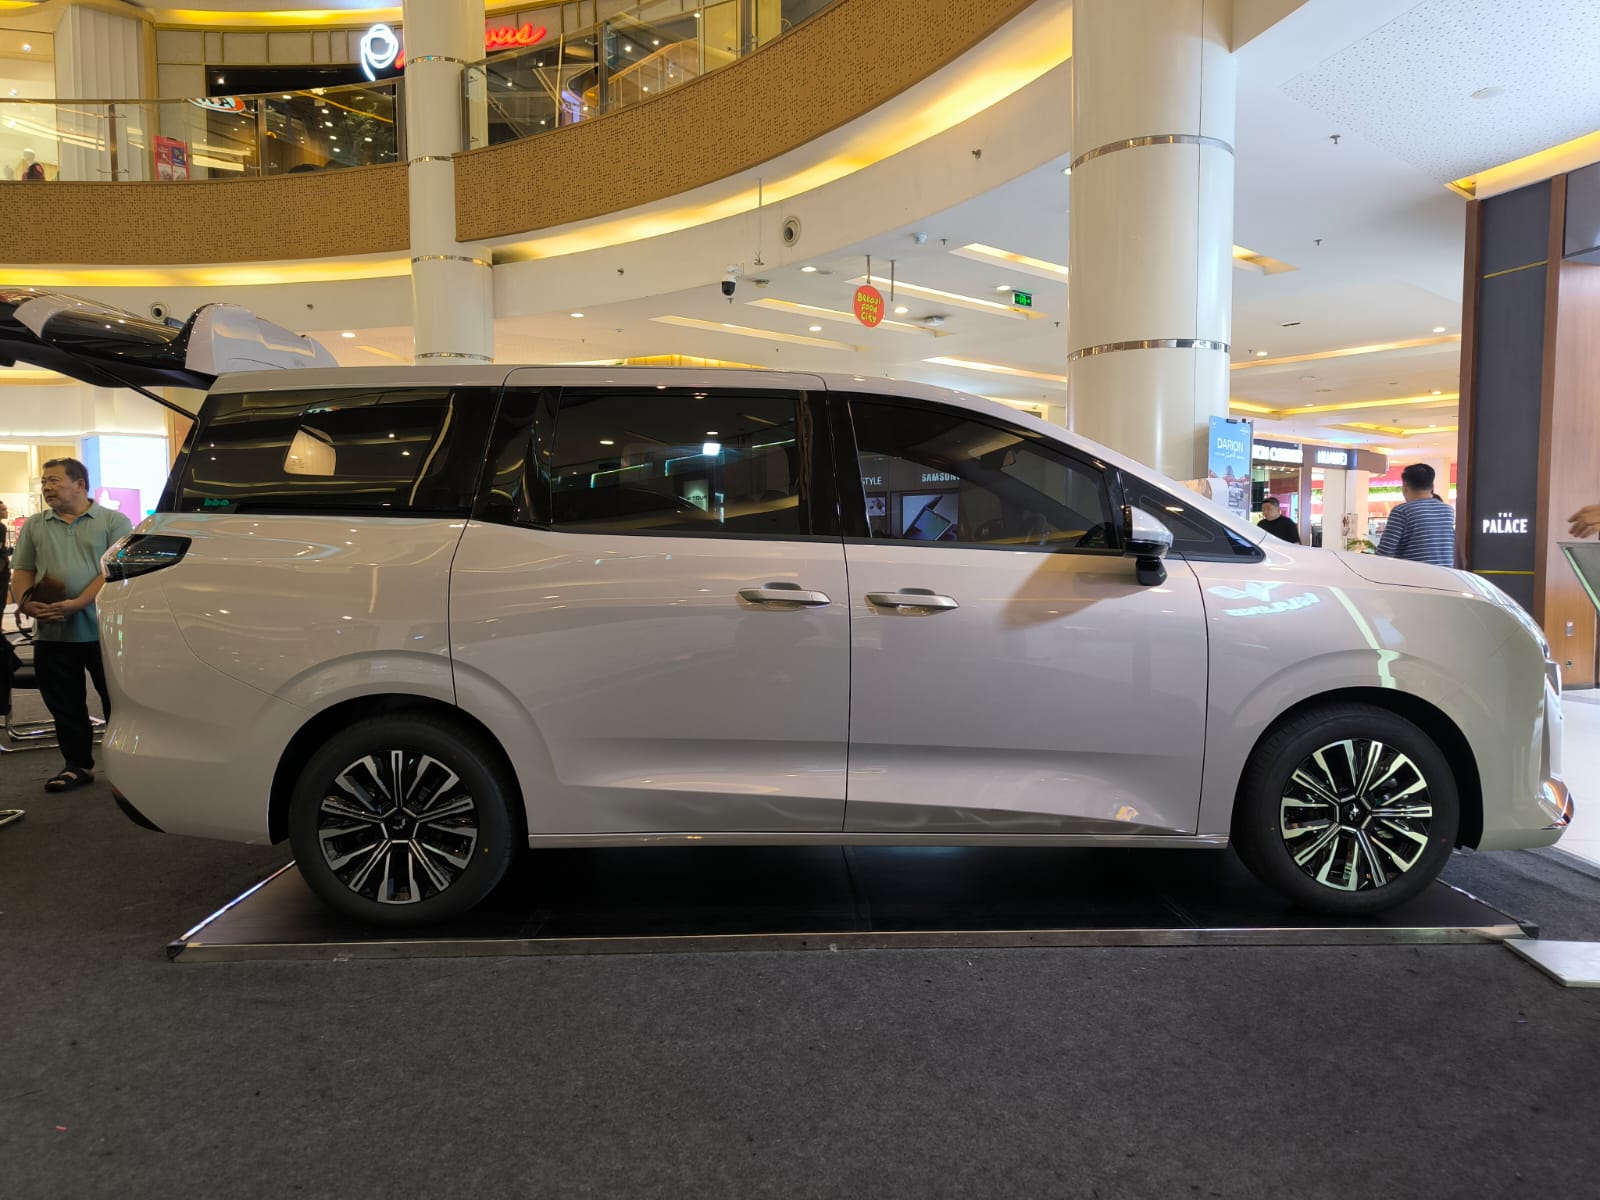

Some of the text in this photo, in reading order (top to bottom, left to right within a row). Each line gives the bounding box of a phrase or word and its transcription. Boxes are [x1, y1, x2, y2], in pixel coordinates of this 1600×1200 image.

[1217, 438, 1244, 452] DARION
[921, 472, 960, 482] SAMSUN
[1482, 518, 1529, 534] PALACE
